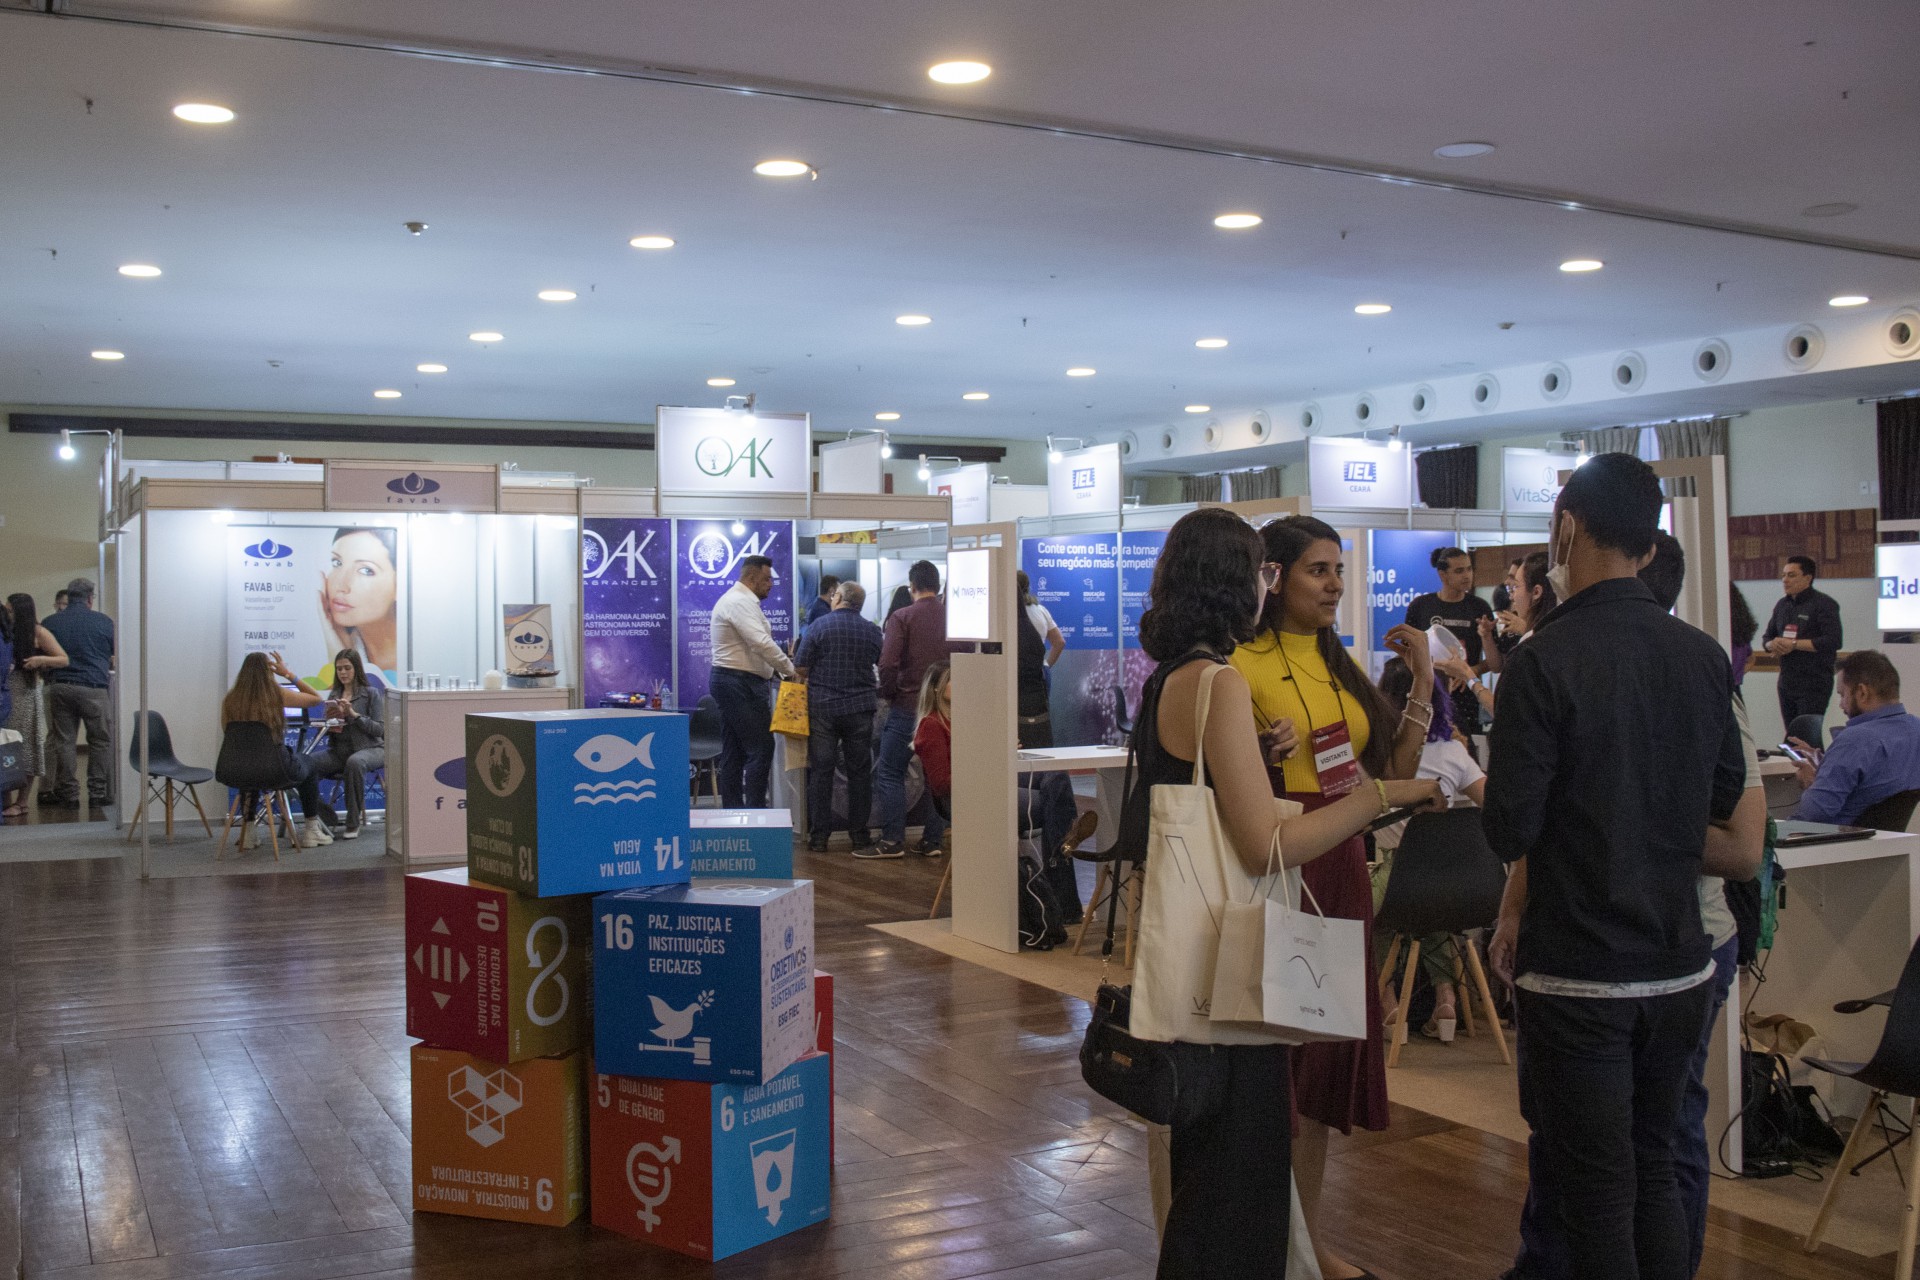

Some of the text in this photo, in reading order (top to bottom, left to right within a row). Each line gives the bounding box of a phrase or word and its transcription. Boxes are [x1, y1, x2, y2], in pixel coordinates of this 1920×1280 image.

[695, 435, 774, 478] OAK
[1075, 469, 1093, 487] IEL
[1347, 463, 1373, 480] IEL
[386, 496, 440, 504] favab
[1512, 487, 1558, 503] VitaSe
[1037, 542, 1159, 557] Conte com o IEL pra tornar
[244, 560, 293, 568] favab
[1037, 560, 1054, 568] seu
[1056, 556, 1092, 571] negócio
[1093, 557, 1114, 568] mais
[1387, 568, 1396, 584] e
[244, 582, 295, 592] FAVAB Unic
[1882, 578, 1919, 597] Rid
[244, 631, 269, 640] FAVAB
[1320, 749, 1348, 765] VISITANTE
[613, 839, 641, 856] ÁGUA
[653, 835, 684, 871] 14
[690, 836, 752, 853] UA POTÁVEL
[518, 845, 535, 882] 13
[599, 860, 641, 877] VIDA NA
[690, 858, 756, 872] ANEAMENTO
[476, 899, 500, 932] 10
[648, 914, 732, 935] PAZ, JUSTIÇA E
[601, 913, 634, 950] 16
[649, 935, 725, 956] INSTITUIÇÕES
[649, 958, 702, 975] EFICAZES
[770, 946, 807, 982] OBJETIVOS
[477, 945, 488, 1037] DESIGUALDADES
[490, 947, 501, 1027] REDUÇÃO DAS
[778, 1003, 800, 1028] ESG FIEC
[597, 1074, 611, 1108] 5
[618, 1078, 664, 1102] IGUALDADE
[766, 1074, 801, 1096] POTÁVEL
[618, 1099, 664, 1123] DE GÊNERO
[720, 1095, 735, 1132] 6
[743, 1093, 804, 1126] E SANEAMENTO
[431, 1165, 529, 1189] E INFRAESTRUTURA
[418, 1183, 529, 1211] INDÚSTRIA, INOVAÇÃO
[536, 1177, 553, 1212] 9
